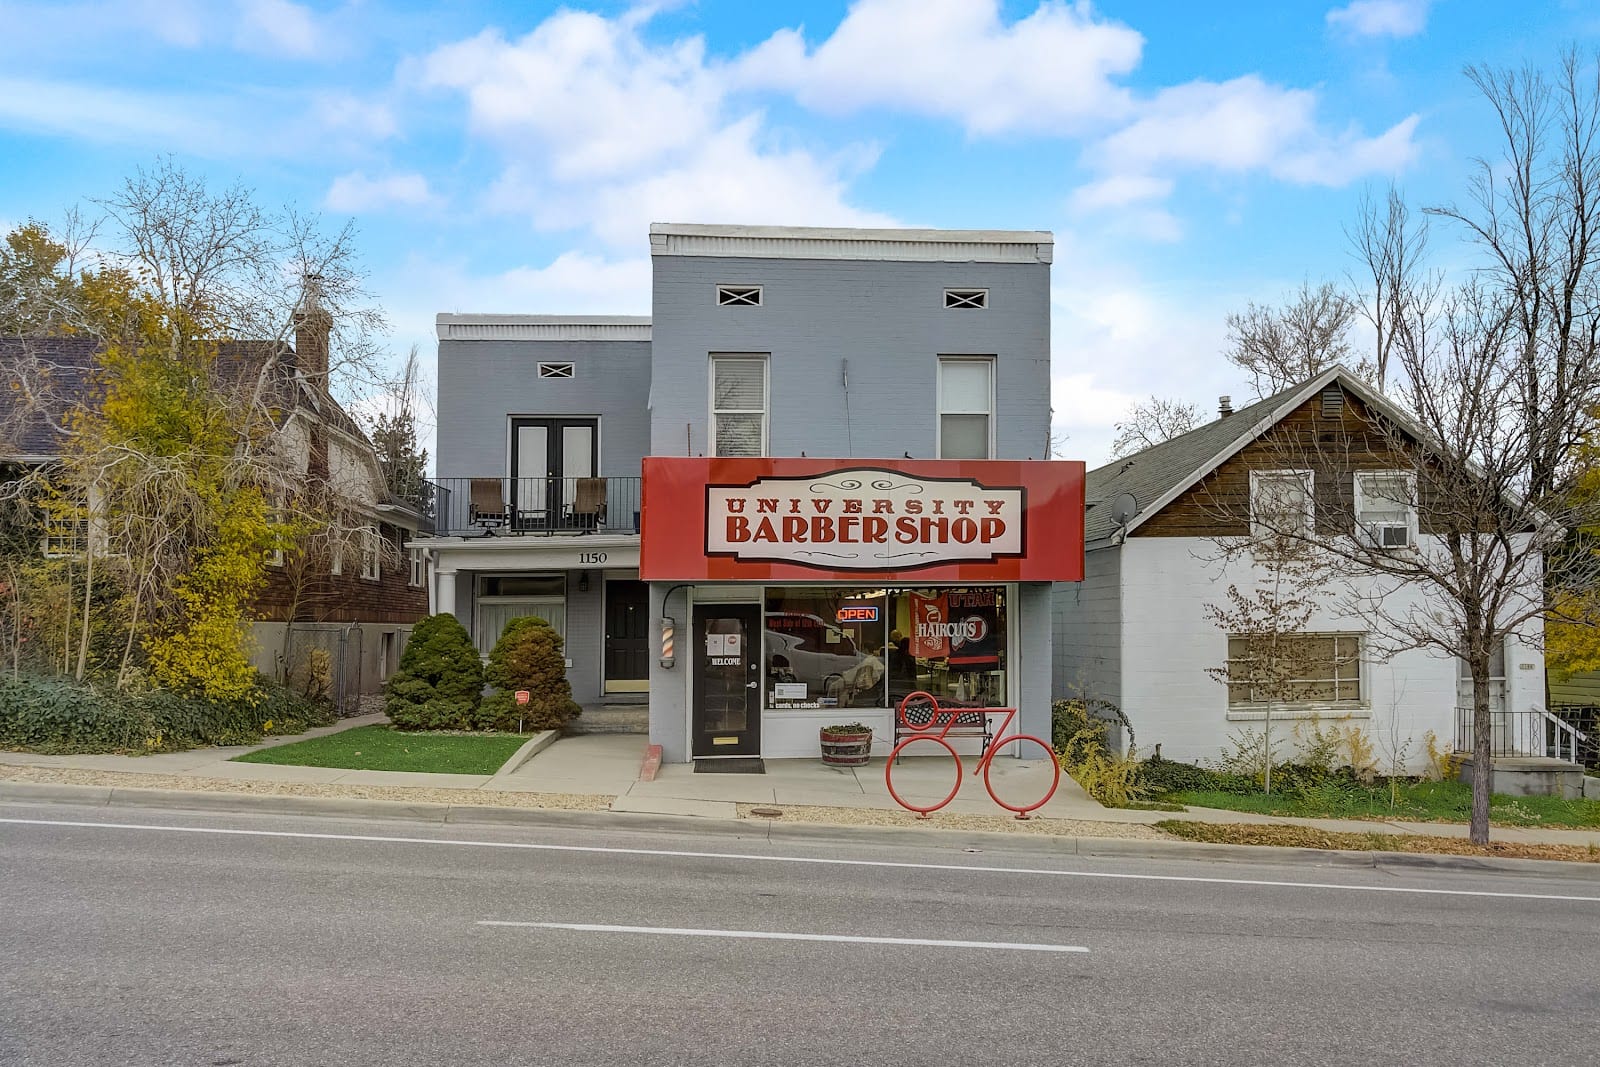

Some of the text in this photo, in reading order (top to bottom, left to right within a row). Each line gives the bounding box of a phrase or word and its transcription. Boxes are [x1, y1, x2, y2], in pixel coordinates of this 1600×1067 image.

[725, 498, 1005, 515] UNIVERSITY
[579, 552, 607, 564] 1150
[949, 592, 995, 608] UTAH
[837, 609, 876, 620] OPEN
[918, 622, 976, 637] HAIRCUTS
[711, 657, 741, 666] WELCOME
